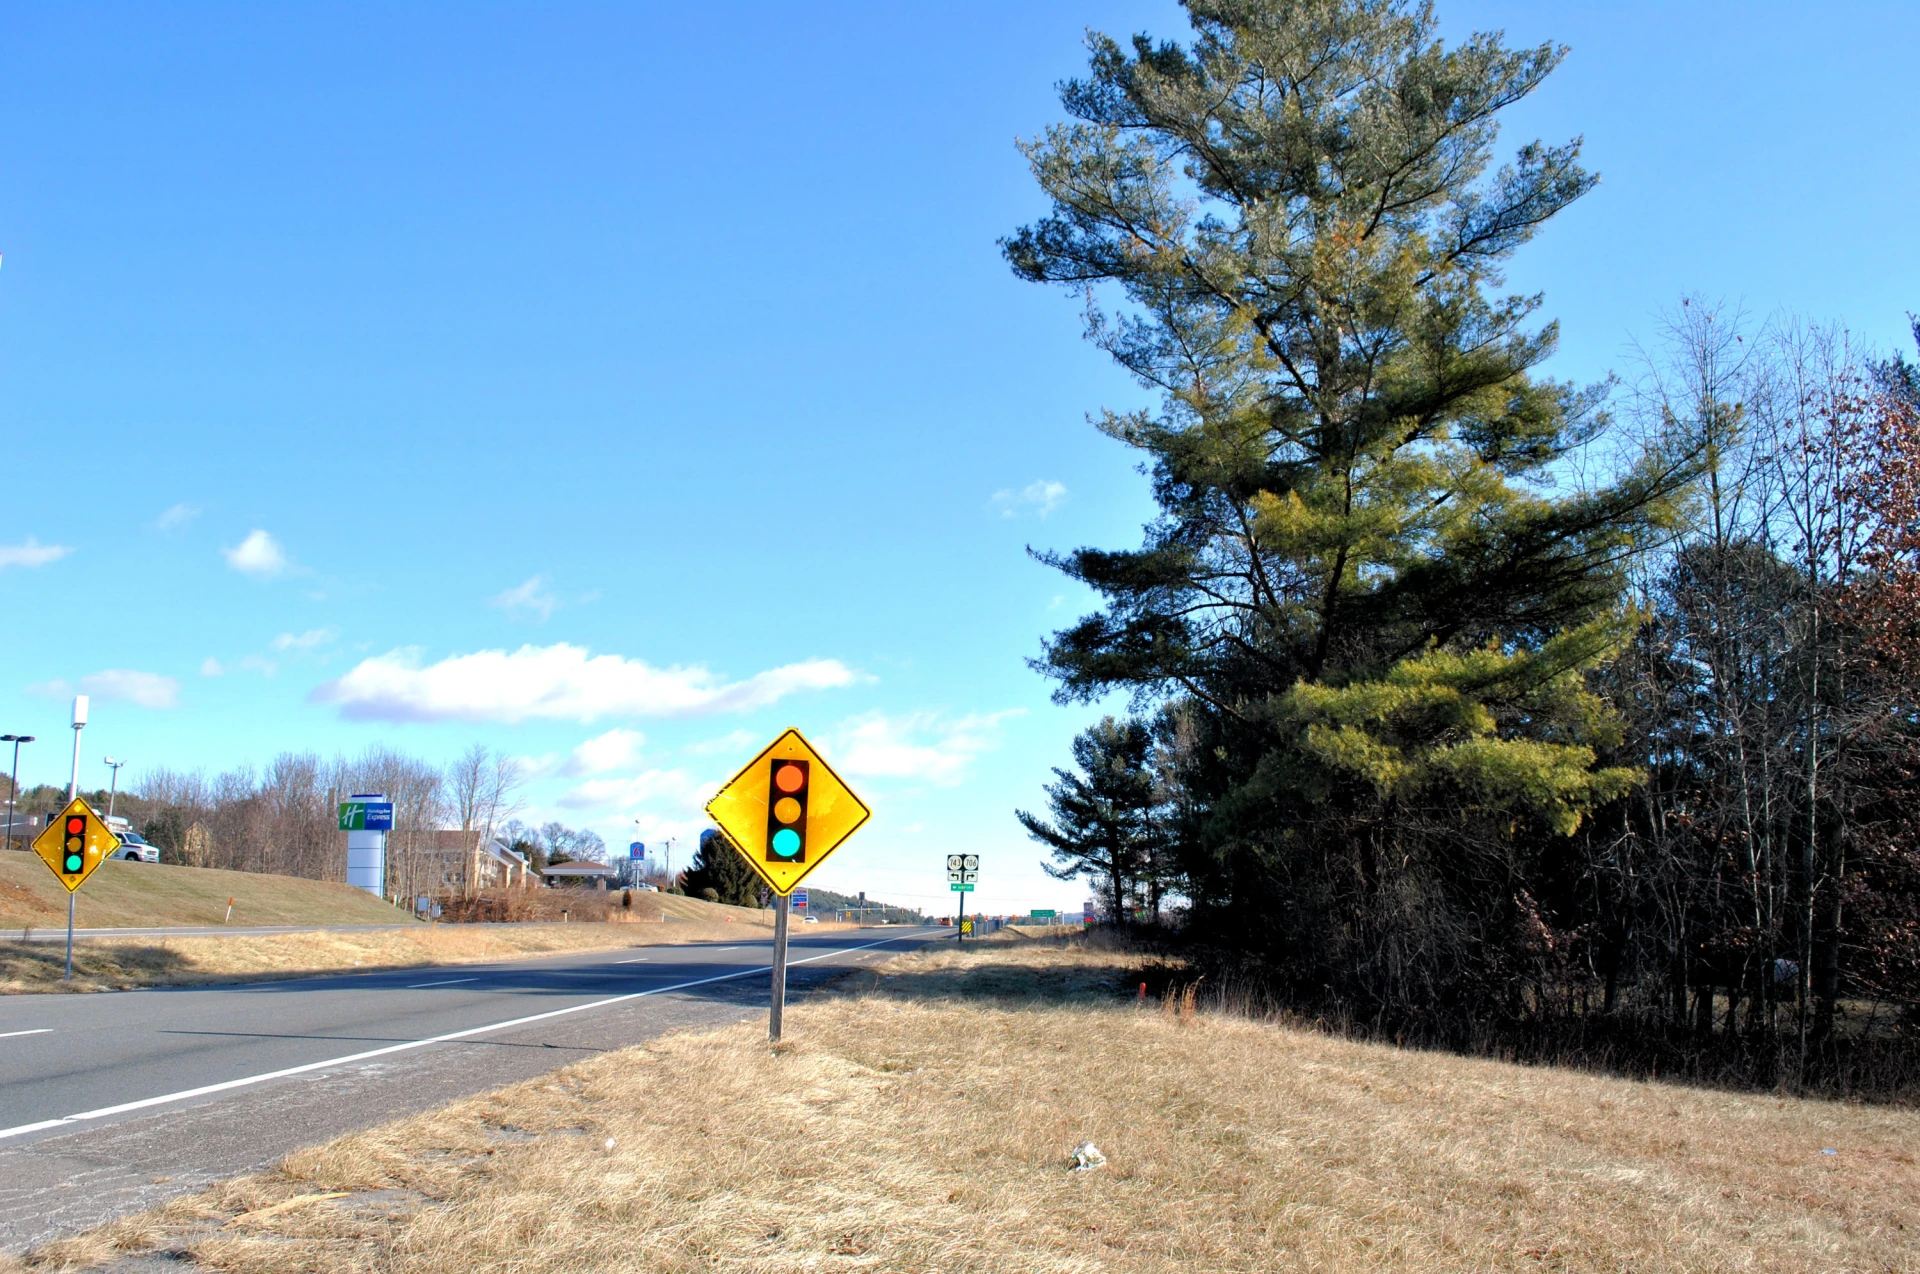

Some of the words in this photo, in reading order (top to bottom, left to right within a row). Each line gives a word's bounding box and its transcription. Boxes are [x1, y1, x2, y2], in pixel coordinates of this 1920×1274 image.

[633, 846, 643, 858] 6
[950, 859, 961, 867] 743
[966, 859, 977, 867] 706
